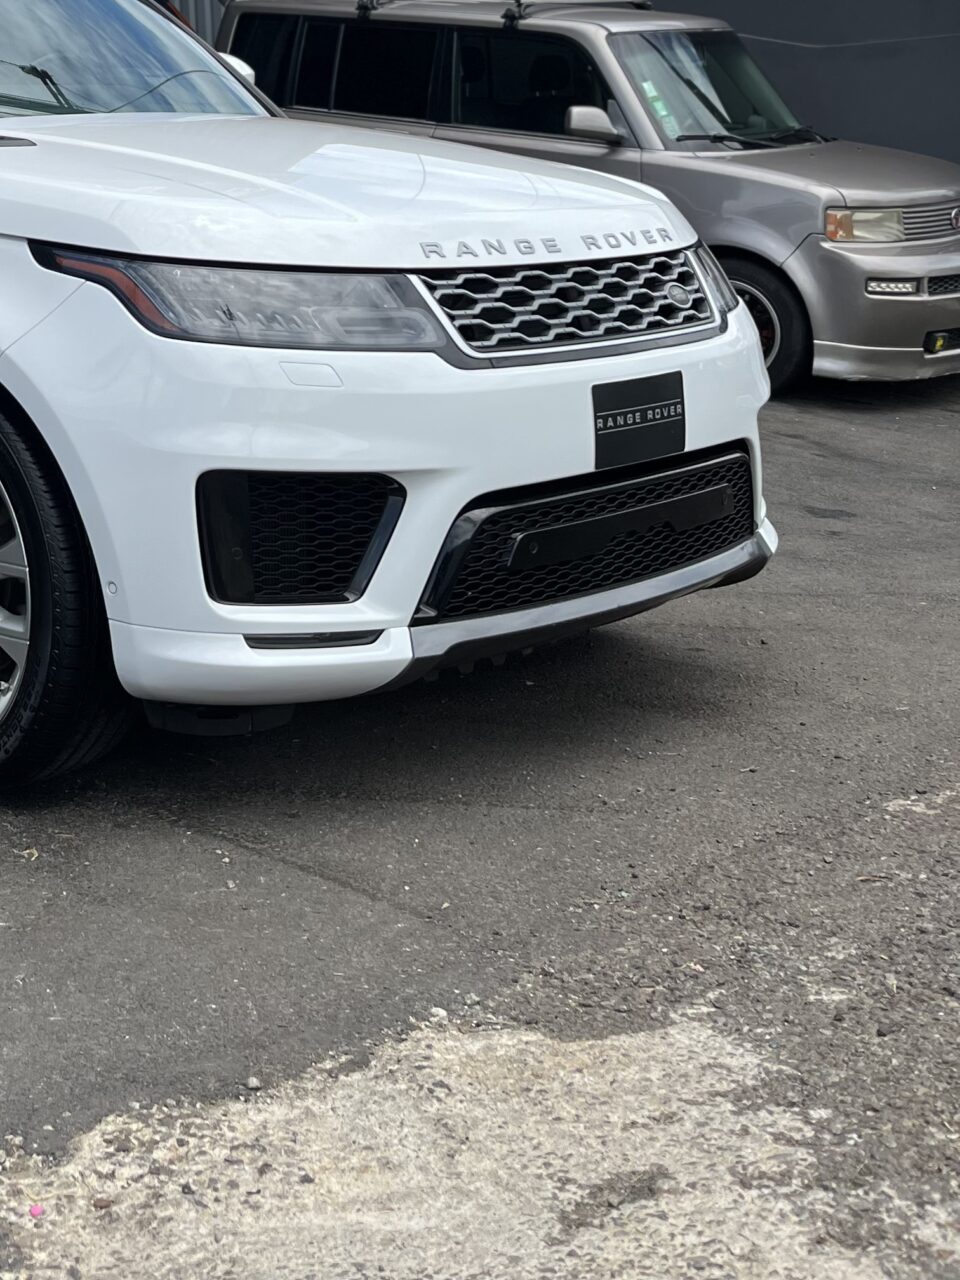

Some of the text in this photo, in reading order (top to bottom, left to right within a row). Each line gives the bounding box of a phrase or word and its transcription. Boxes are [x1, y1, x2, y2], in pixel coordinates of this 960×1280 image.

[419, 227, 673, 258] RANGE ROVER
[596, 404, 683, 429] RANGE ROVER
